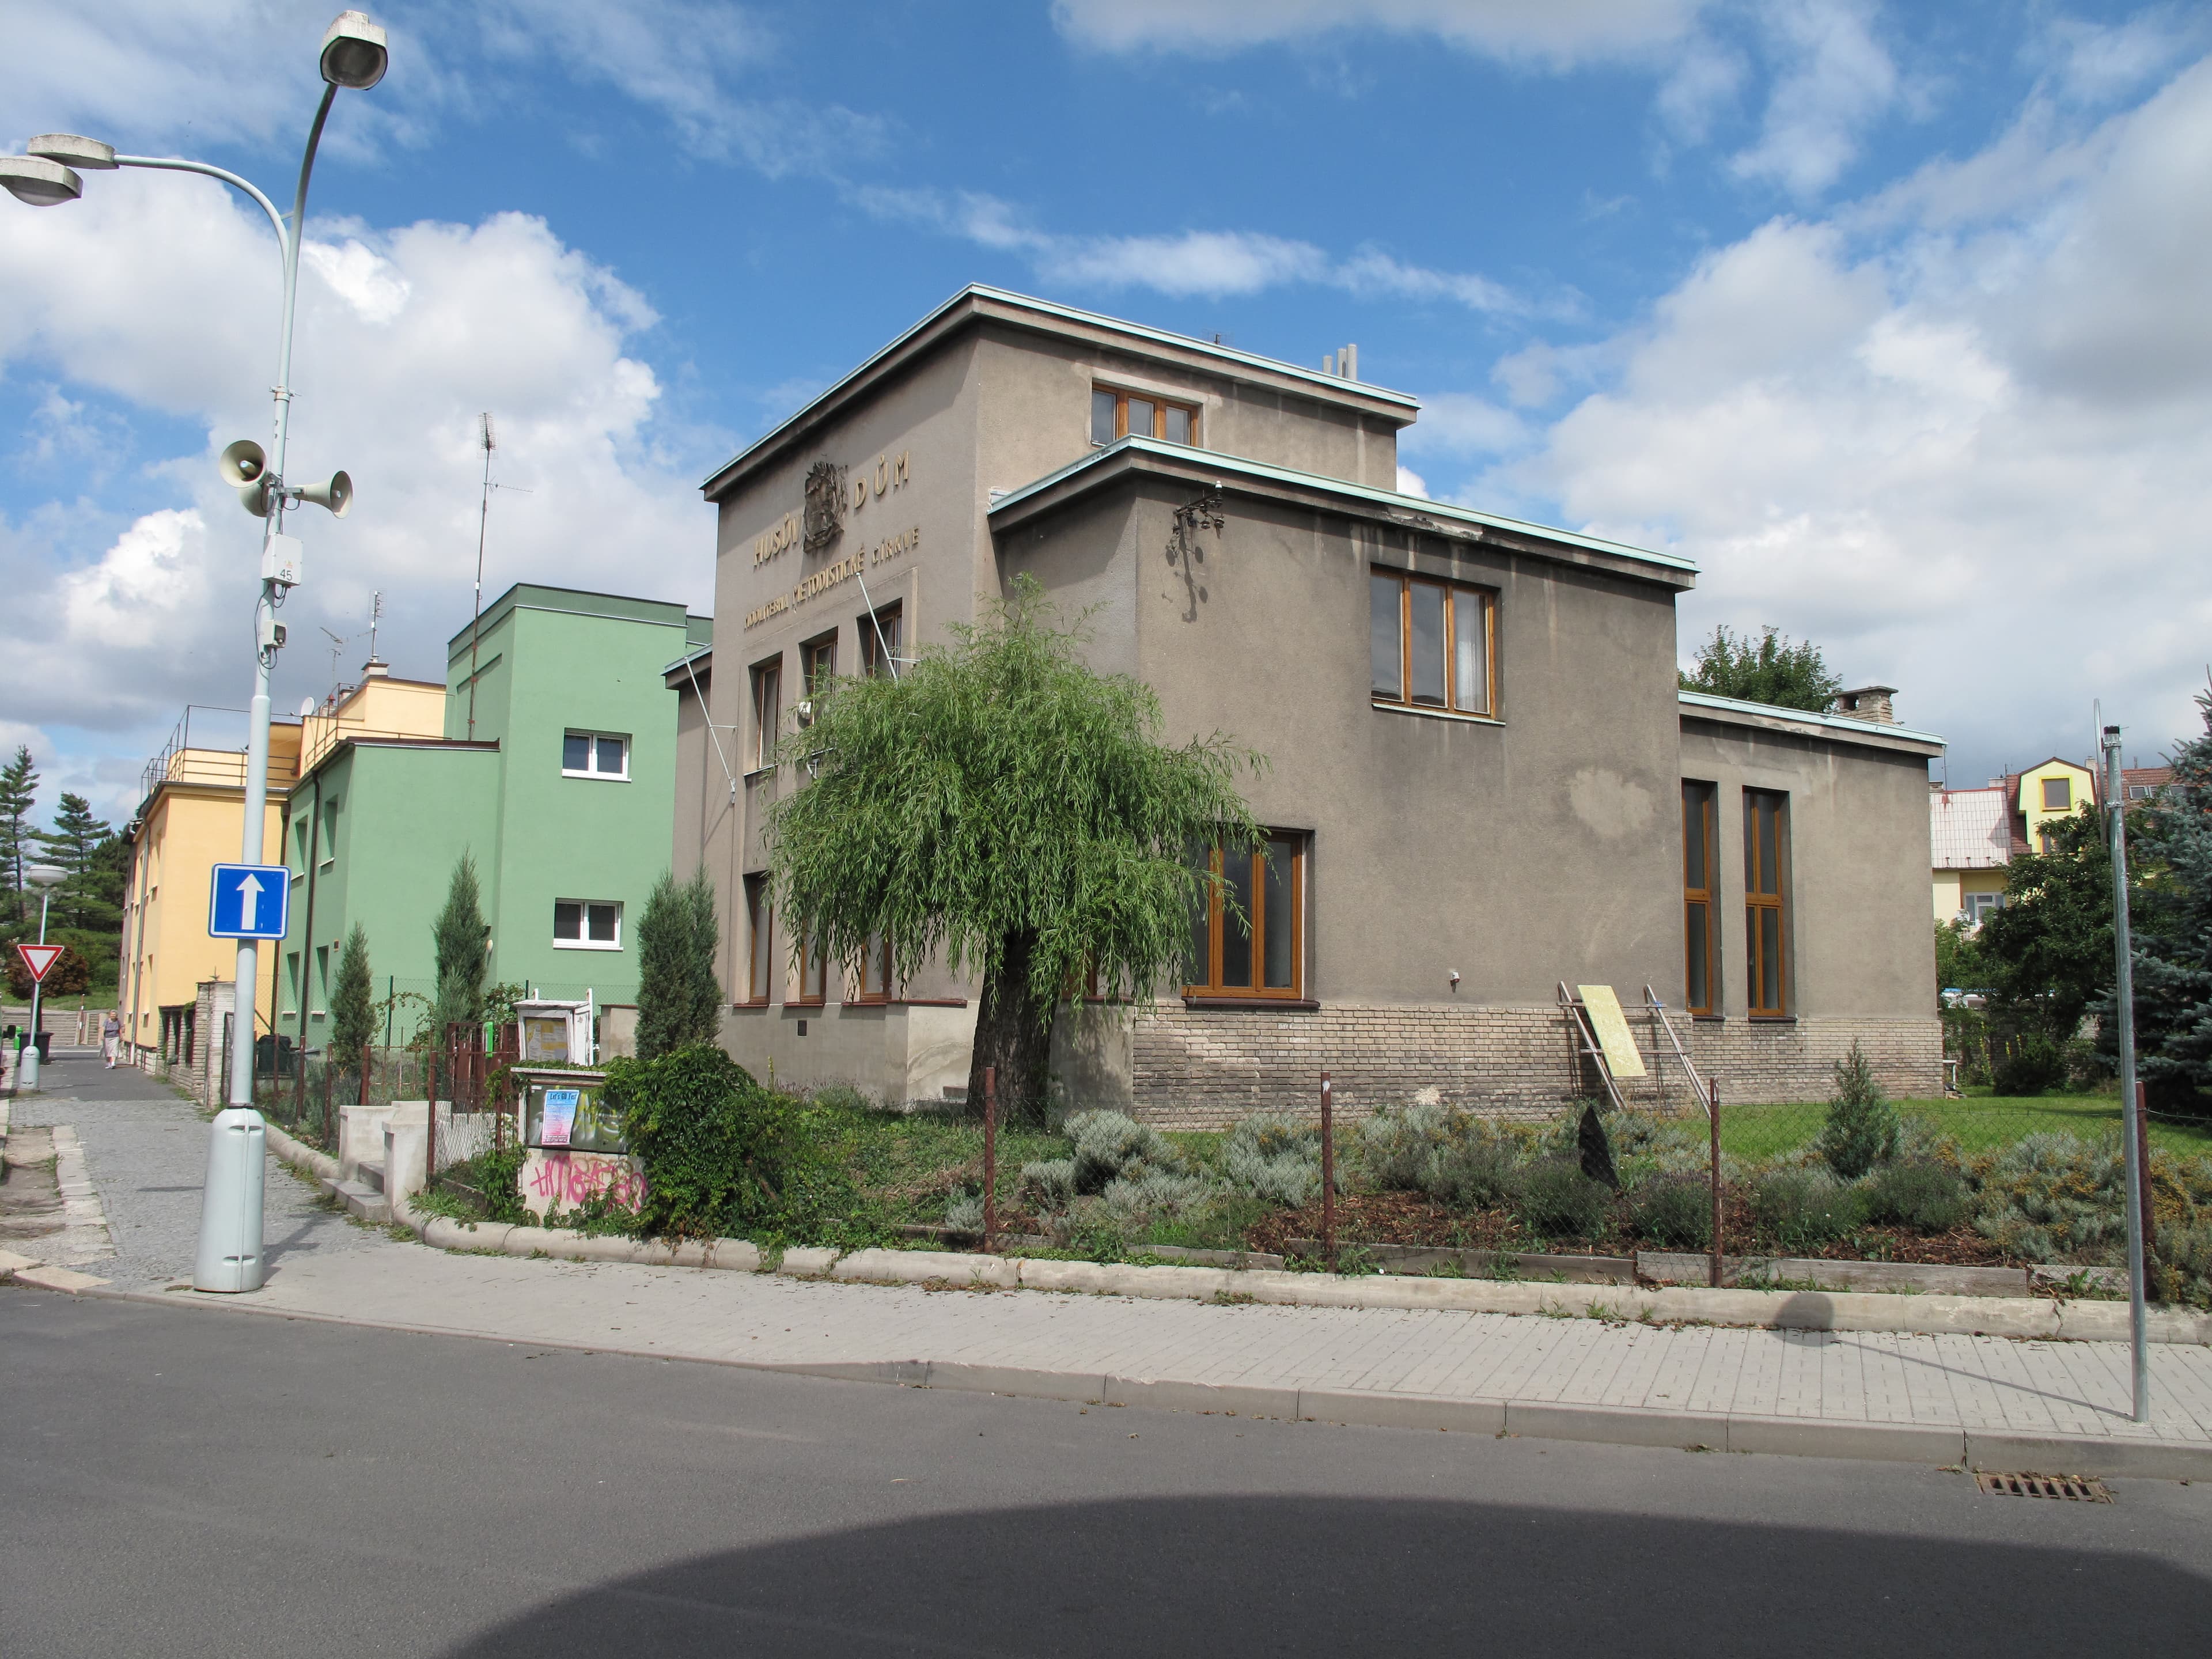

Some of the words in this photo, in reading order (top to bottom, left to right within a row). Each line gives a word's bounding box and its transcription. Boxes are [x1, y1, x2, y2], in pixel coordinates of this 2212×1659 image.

[754, 512, 801, 566] HUSŮV
[854, 450, 908, 508] DŮM
[280, 569, 293, 581] 45
[744, 593, 789, 628] MODLITEBNA
[793, 544, 865, 605] METODISTICKÉ
[872, 525, 919, 563] CÍRKVE
